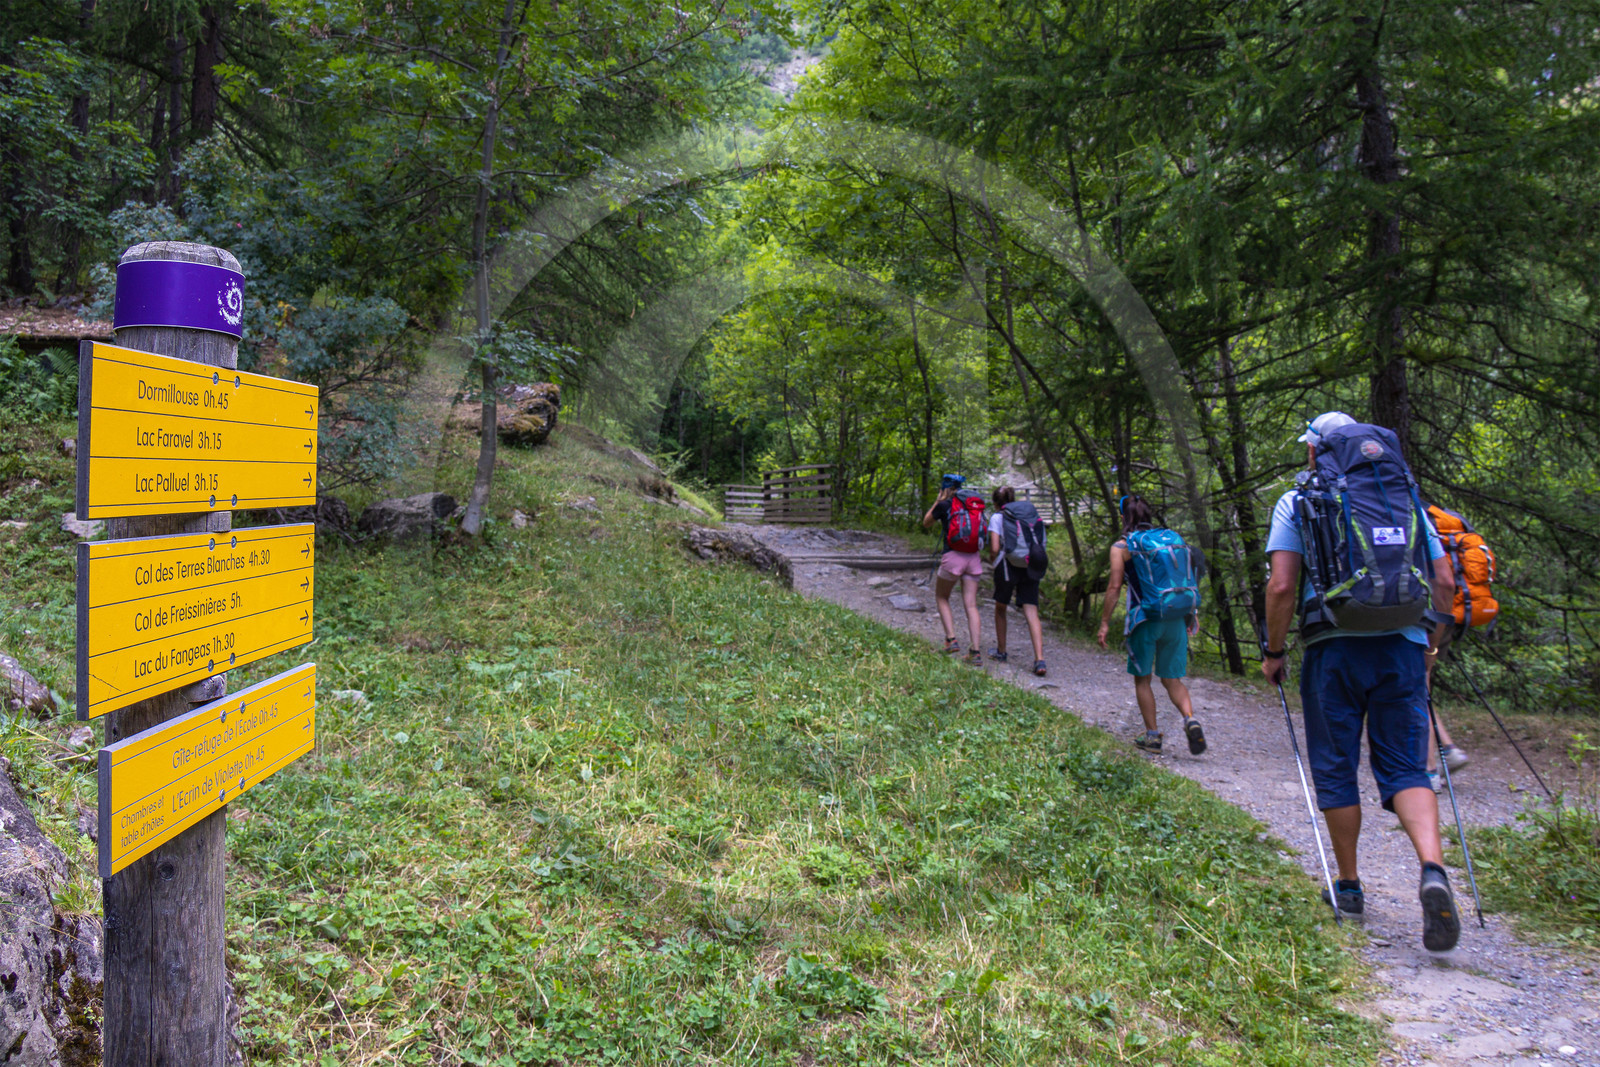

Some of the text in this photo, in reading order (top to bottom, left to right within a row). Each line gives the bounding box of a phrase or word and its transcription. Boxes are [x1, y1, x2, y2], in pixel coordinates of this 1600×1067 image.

[138, 380, 229, 411] Dormillouse 0h.45
[137, 427, 222, 451] Lac Faravel 3h.15
[135, 472, 219, 493] Lac Palluel 3h.15
[135, 548, 271, 586] Col des Terres Blanches 4h.30
[134, 591, 244, 632] Col de Freissinières 5h.
[135, 632, 236, 678] Lac du Fangeas 1h.30
[172, 702, 278, 769] Gîte-refuge de l'Ecole 0h.45
[172, 745, 265, 813] L'Ecrin de Violette 0h.45
[121, 795, 164, 829] Chambres et
[121, 816, 164, 848] table d'hôtes
